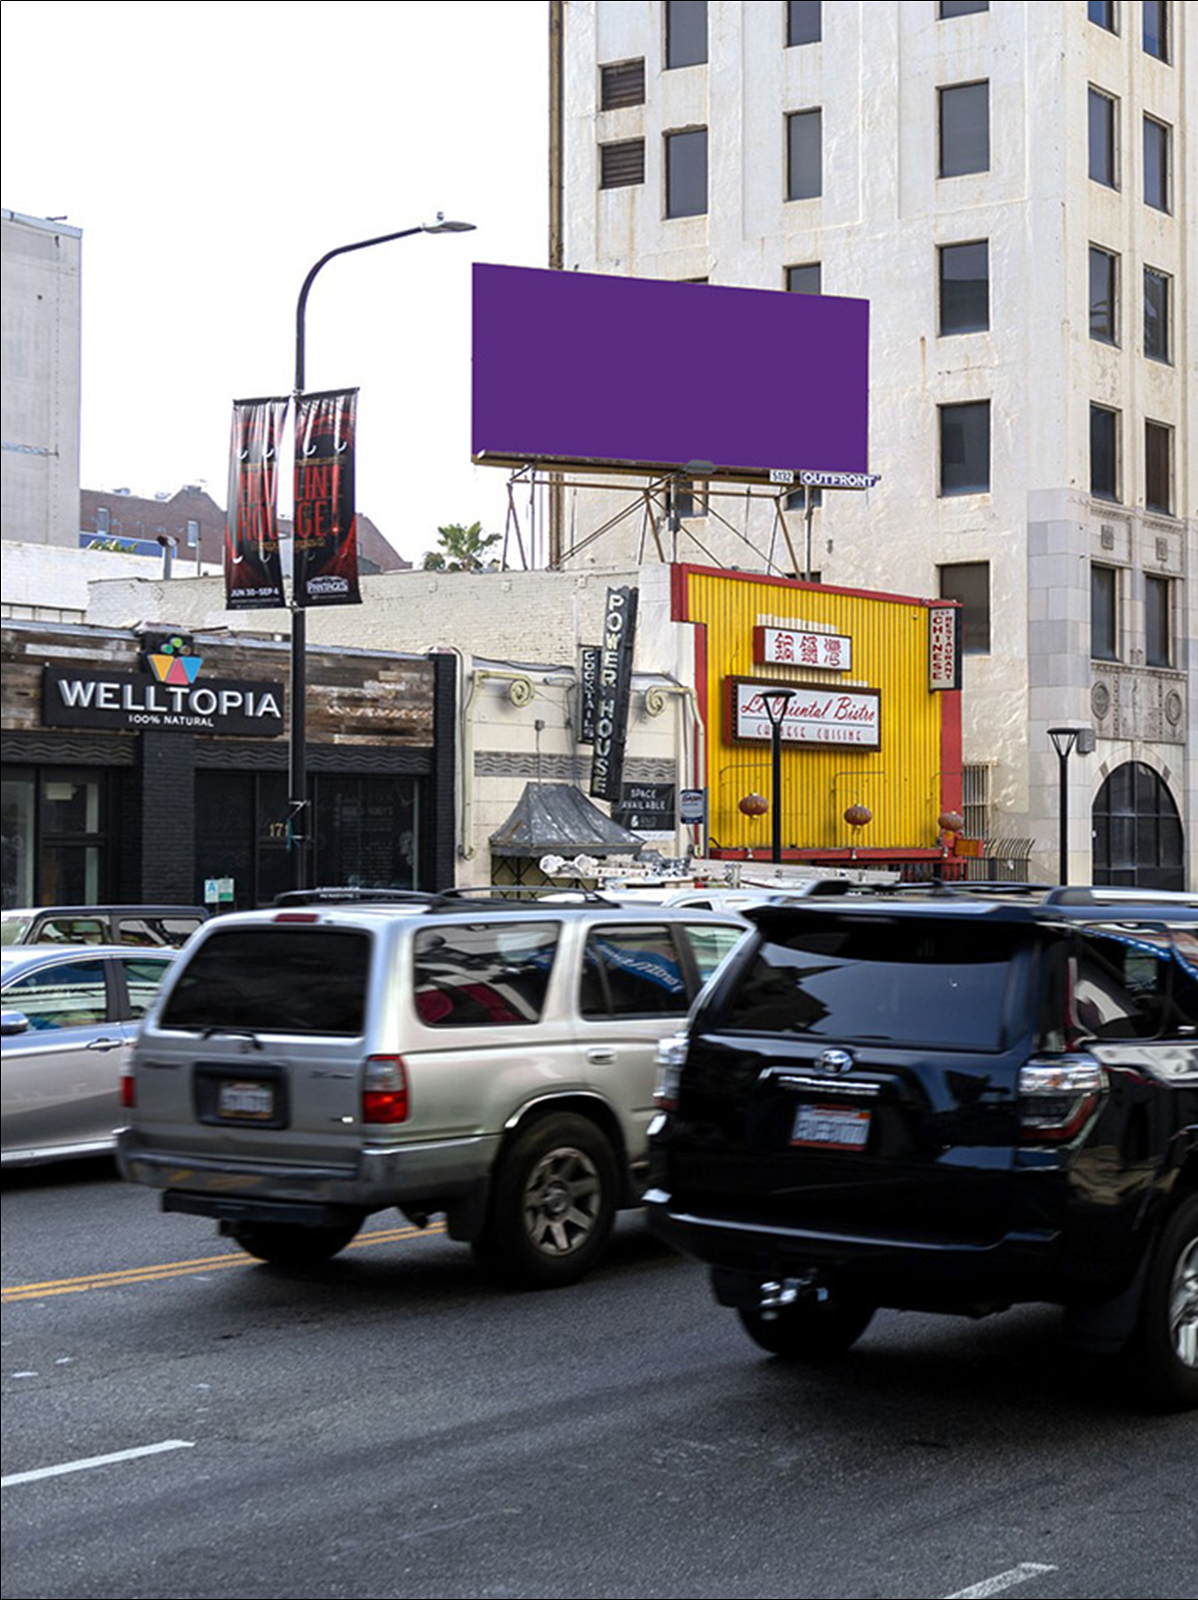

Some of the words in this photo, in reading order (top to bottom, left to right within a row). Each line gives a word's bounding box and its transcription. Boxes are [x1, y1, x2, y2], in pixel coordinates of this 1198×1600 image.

[601, 594, 625, 688] POWER
[932, 616, 943, 680] CHINESE
[57, 679, 282, 719] WELLTOPIA
[740, 694, 764, 714] Le
[834, 696, 876, 721] Bistro
[128, 714, 161, 725] 100%
[163, 715, 215, 728] NATURAL
[757, 724, 806, 738] CHESE
[817, 728, 862, 742] CUISINE
[593, 699, 615, 794] HOUSE
[621, 801, 666, 810] AVAILABLE
[630, 788, 657, 799] SPACE
